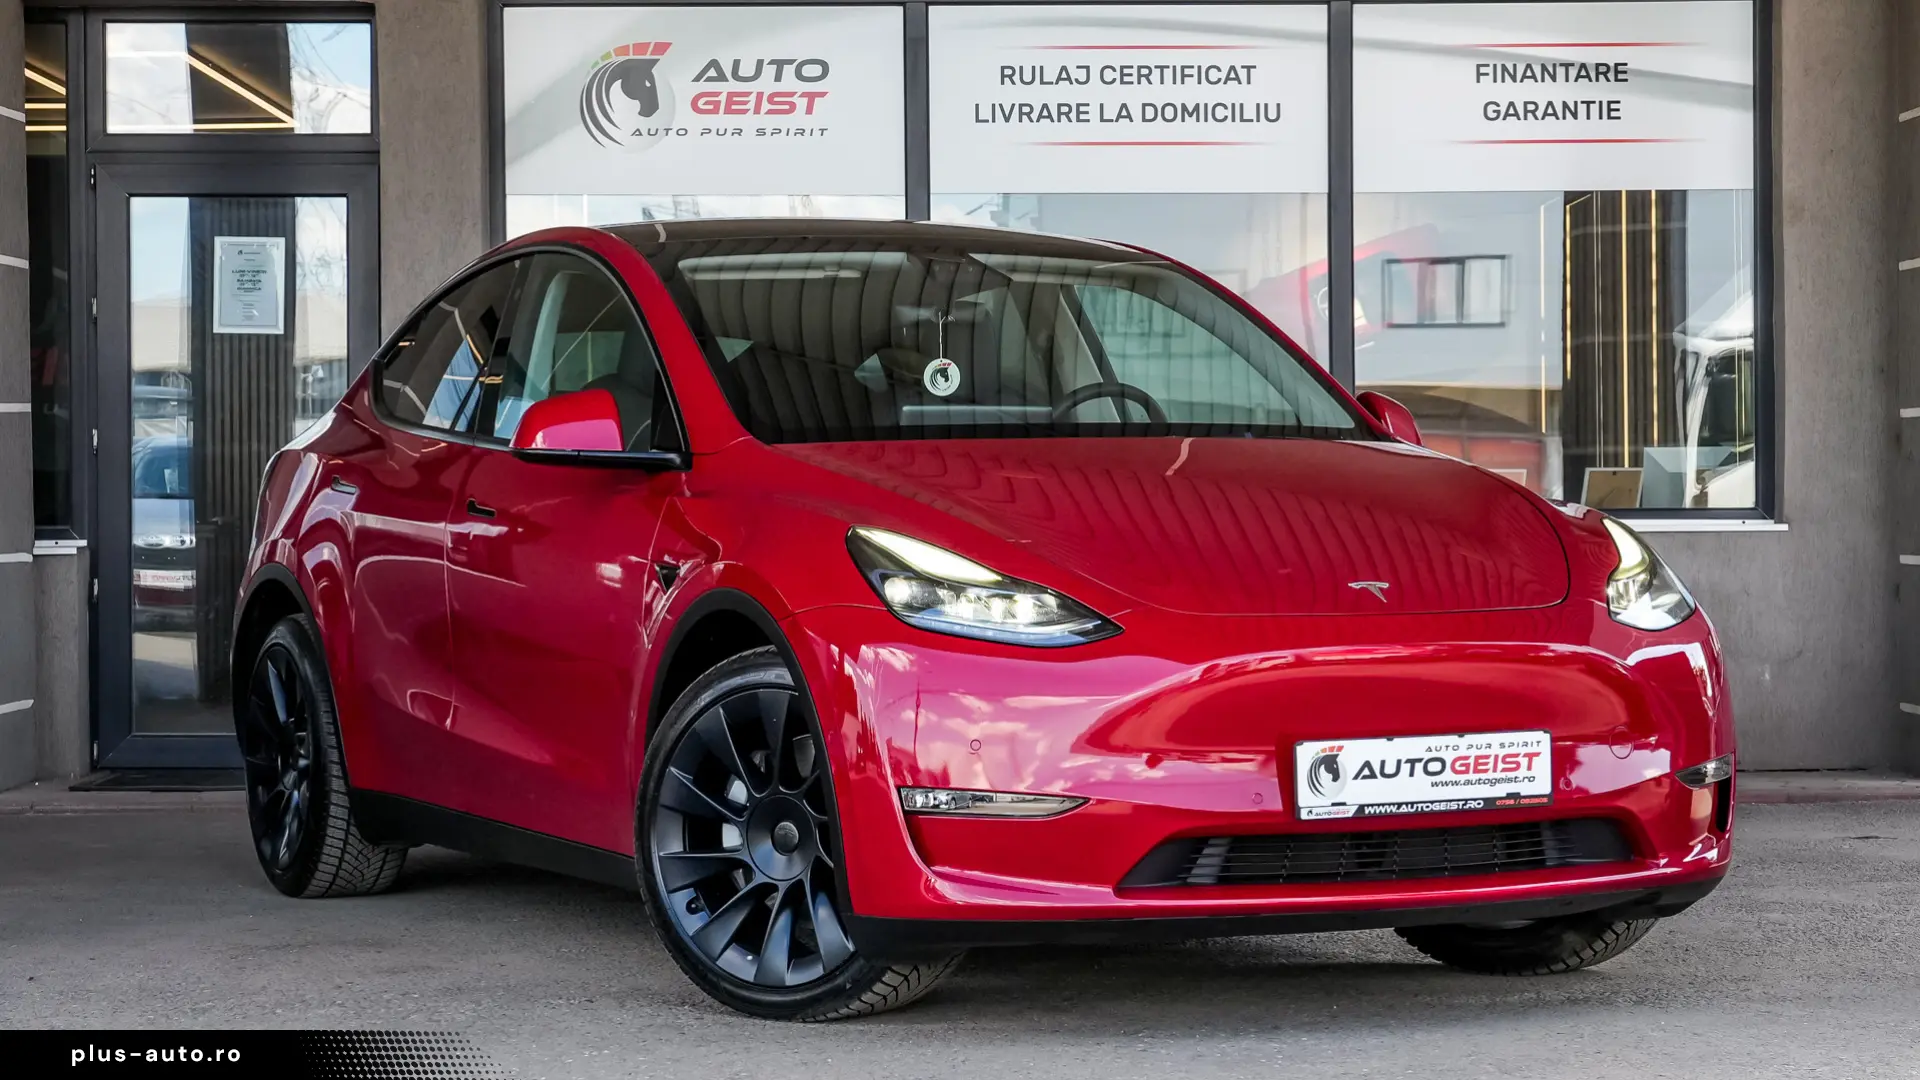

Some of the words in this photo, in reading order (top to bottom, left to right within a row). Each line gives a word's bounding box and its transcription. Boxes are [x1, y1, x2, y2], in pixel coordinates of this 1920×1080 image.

[690, 58, 830, 83] AUTO
[1000, 65, 1091, 86] RULAJ
[1099, 64, 1257, 86] CERTIFICAT
[1475, 62, 1629, 84] FINANTARE
[690, 91, 829, 116] GEIST
[974, 102, 1091, 124] LIVRARE
[1099, 102, 1134, 123] LA
[1141, 102, 1281, 123] DOMICILIU
[1483, 99, 1622, 122] GARANTIE
[630, 127, 689, 137] AUTO
[700, 127, 743, 137] PUR
[755, 127, 829, 137] SPIRIT
[1424, 744, 1460, 753] AUTO
[1466, 742, 1493, 751] PUR
[1498, 740, 1542, 749] SPIRIT
[1430, 774, 1536, 788] www.autogeist.ro
[1364, 799, 1484, 815] WWW.AUTOGEIST.RO
